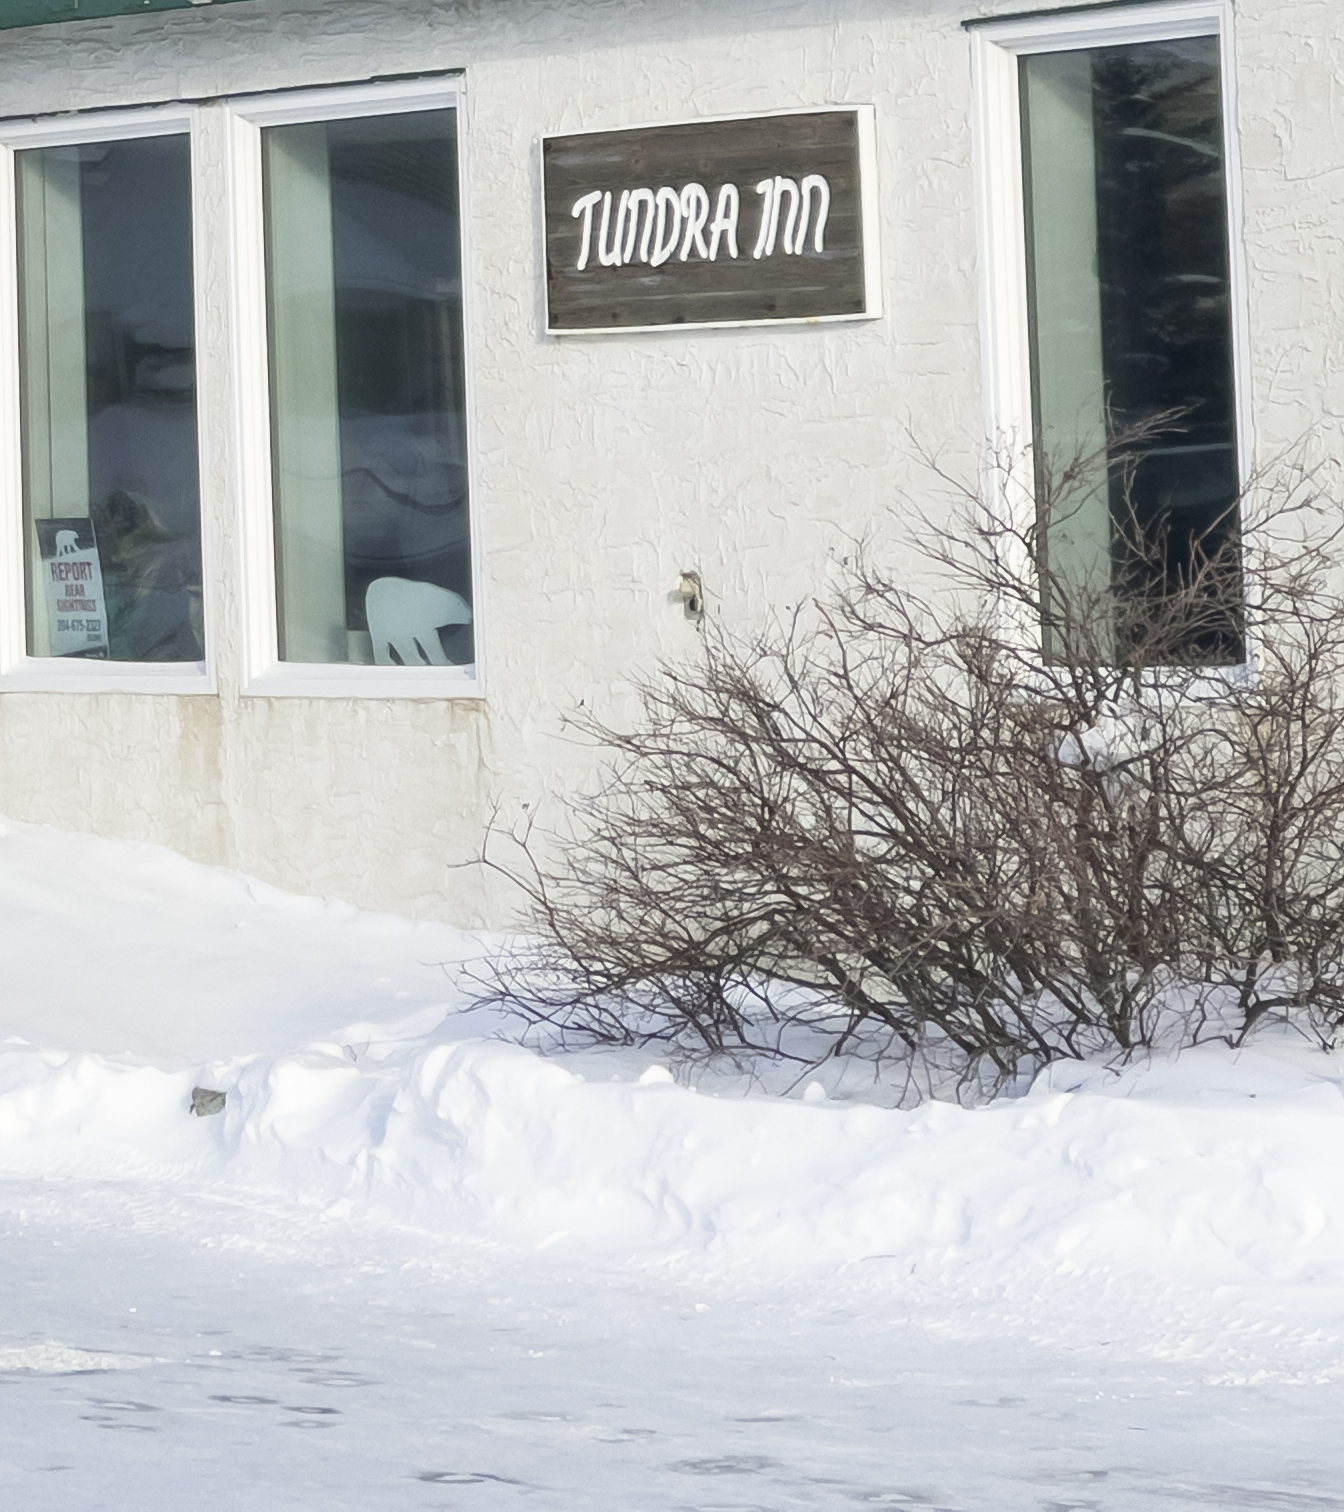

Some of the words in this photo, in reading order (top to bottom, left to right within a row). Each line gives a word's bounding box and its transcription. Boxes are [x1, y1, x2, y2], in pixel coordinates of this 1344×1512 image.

[571, 182, 739, 271] TUNDRA
[753, 174, 830, 260] INN
[50, 561, 93, 581] REPORT
[65, 584, 85, 597] BEAR
[56, 599, 97, 612] SIGHTINGS
